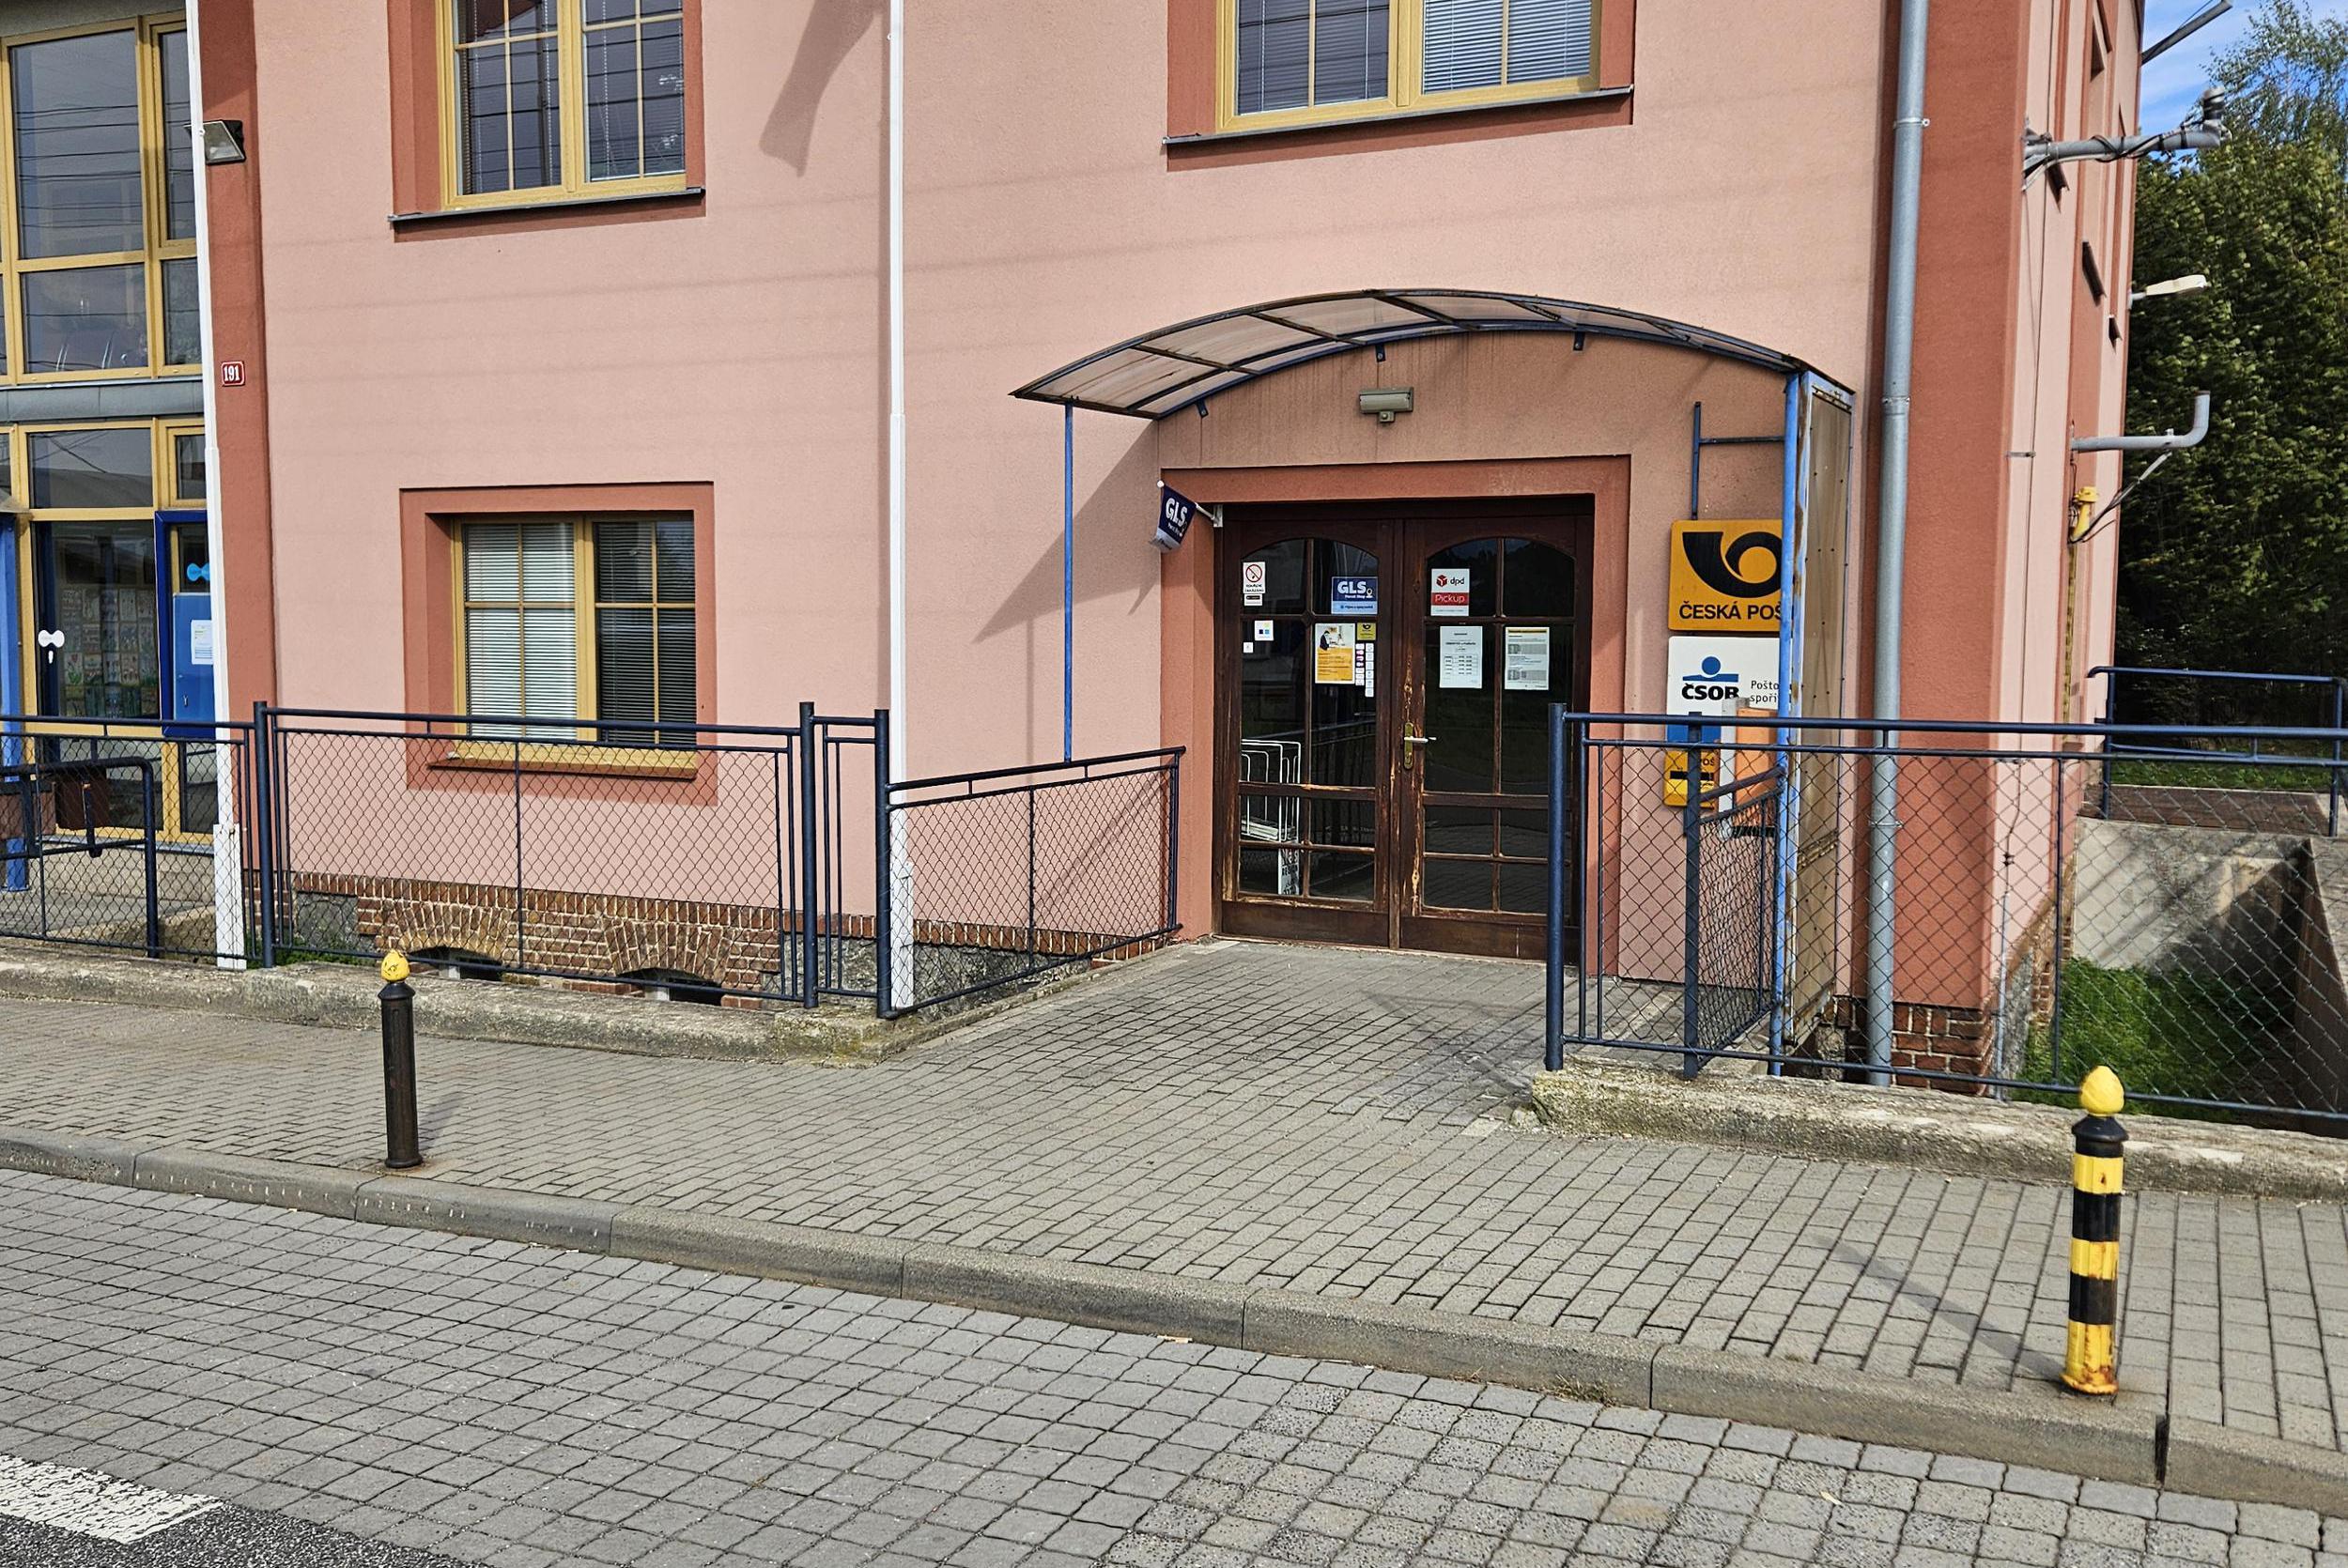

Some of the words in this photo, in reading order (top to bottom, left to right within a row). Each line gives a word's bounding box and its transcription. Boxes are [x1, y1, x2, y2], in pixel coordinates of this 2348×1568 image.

[224, 364, 240, 381] 191
[1166, 498, 1187, 527] GLS
[1337, 580, 1367, 593] GLS
[1450, 576, 1465, 586] dpd
[1435, 593, 1465, 604] Pickup
[1679, 600, 1741, 620] ČESKÁ
[1681, 683, 1739, 700] ČSOB
